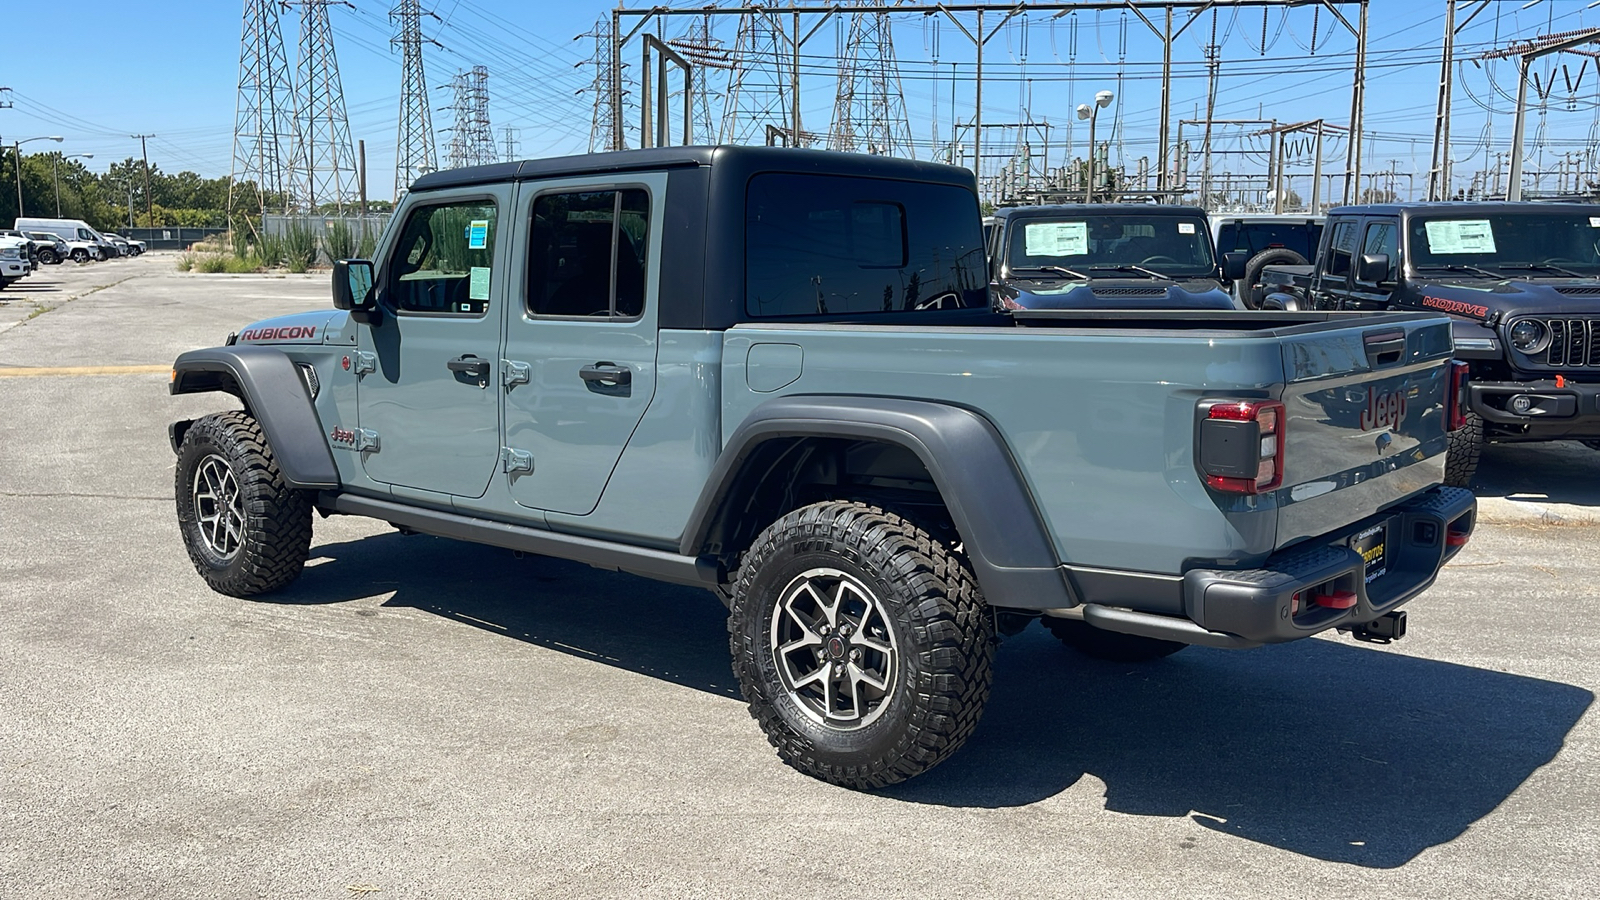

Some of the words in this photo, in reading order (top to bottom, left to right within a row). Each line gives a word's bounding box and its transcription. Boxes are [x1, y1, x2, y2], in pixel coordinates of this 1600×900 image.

[1423, 296, 1488, 317] MOJAVE
[241, 326, 316, 341] RUBICON
[1360, 386, 1407, 431] Jeep
[330, 425, 354, 446] Jeep
